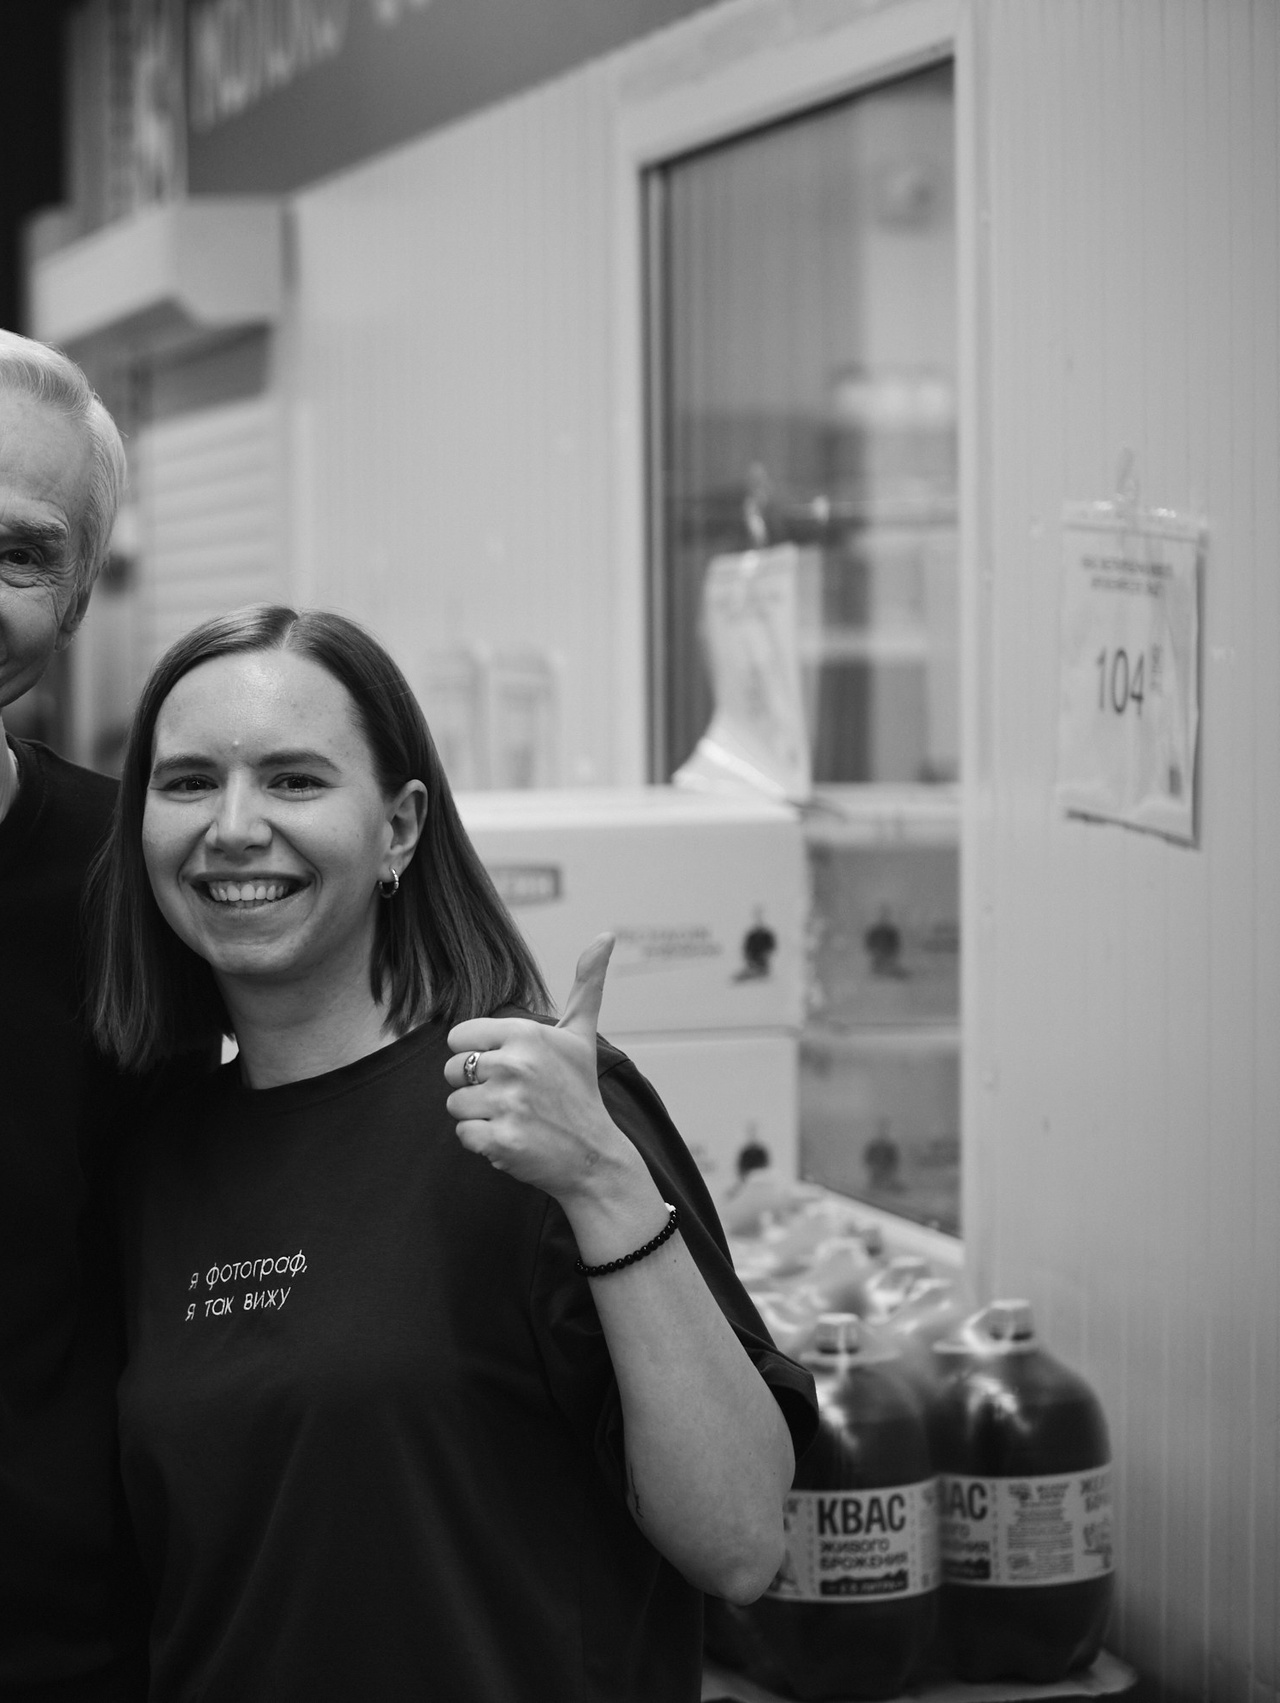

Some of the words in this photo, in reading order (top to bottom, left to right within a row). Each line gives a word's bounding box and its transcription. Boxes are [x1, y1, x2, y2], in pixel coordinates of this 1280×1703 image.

[1095, 647, 1145, 717] 104
[188, 1272, 200, 1291] я
[206, 1249, 308, 1291] фотограф,
[185, 1303, 197, 1321] я
[204, 1296, 235, 1317] так
[243, 1286, 292, 1311] вижу
[818, 1493, 906, 1535] КВАС
